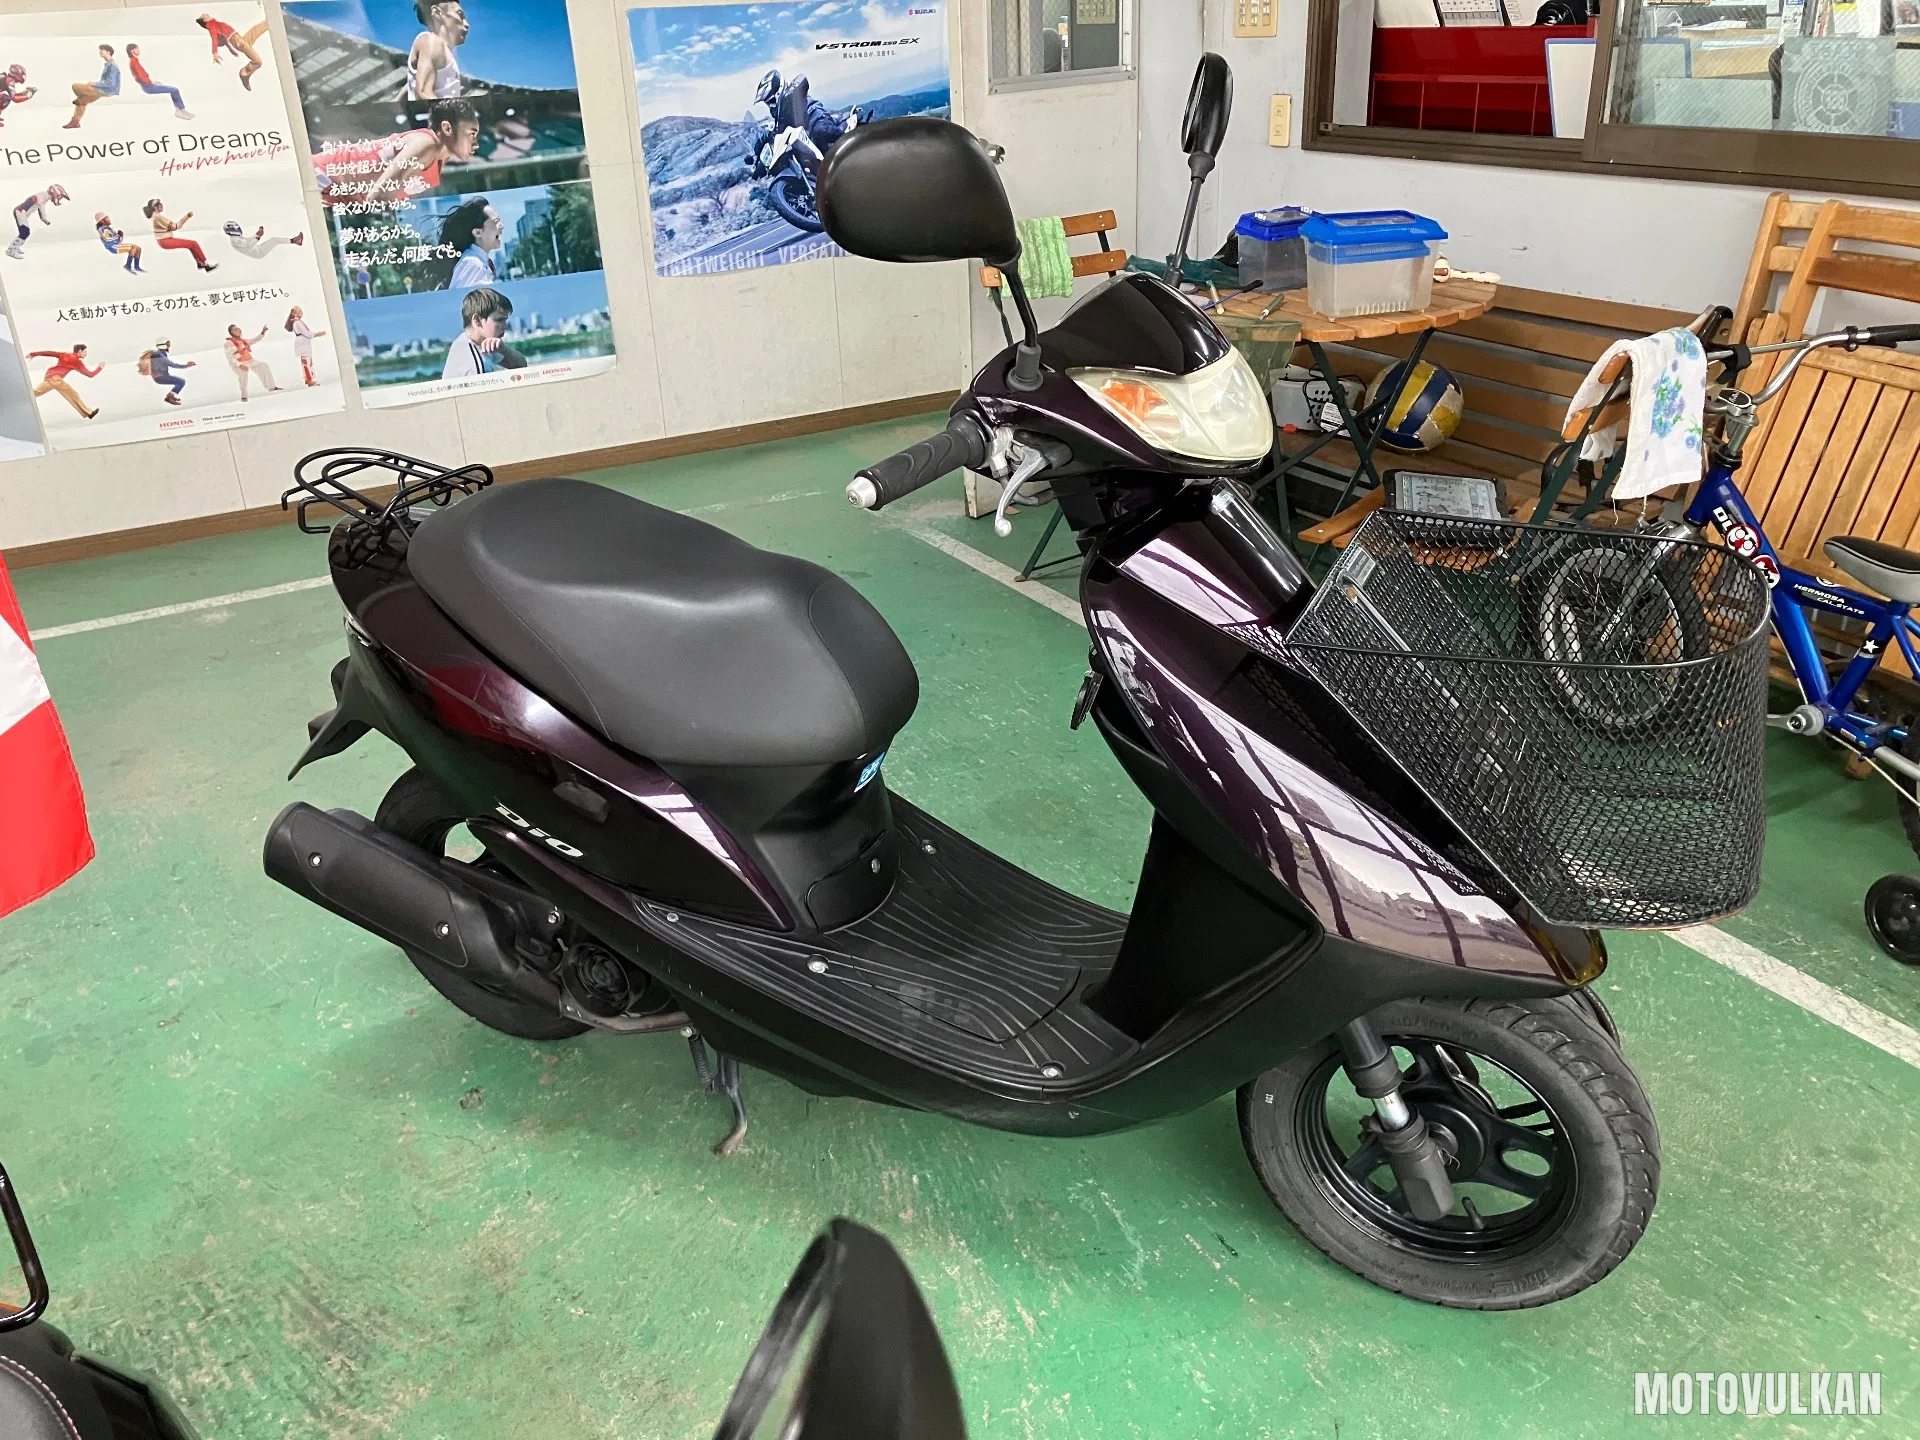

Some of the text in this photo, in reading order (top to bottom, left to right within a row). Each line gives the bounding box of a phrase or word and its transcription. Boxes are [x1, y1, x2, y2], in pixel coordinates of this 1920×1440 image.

[815, 40, 882, 51] V-STROM
[0, 130, 282, 165] he Power of Dreams
[320, 138, 409, 155] 負けたくないから。
[159, 157, 194, 176] How
[224, 148, 267, 165] move
[326, 156, 425, 177] 自分を超えたいから。
[329, 175, 431, 197] あきらめたくないから。
[332, 197, 417, 217] 強くなりたいから。
[339, 223, 421, 247] 夢があるから。
[343, 241, 462, 269] 走るんだ。何度でも。
[661, 249, 766, 277] IGHTWEIGHT
[56, 286, 290, 323] 人を動かすもの。その力を、夢と呼びたい。
[542, 366, 572, 375] HONDA
[159, 419, 194, 428] HONDA
[1793, 583, 1845, 604] HERMOSA
